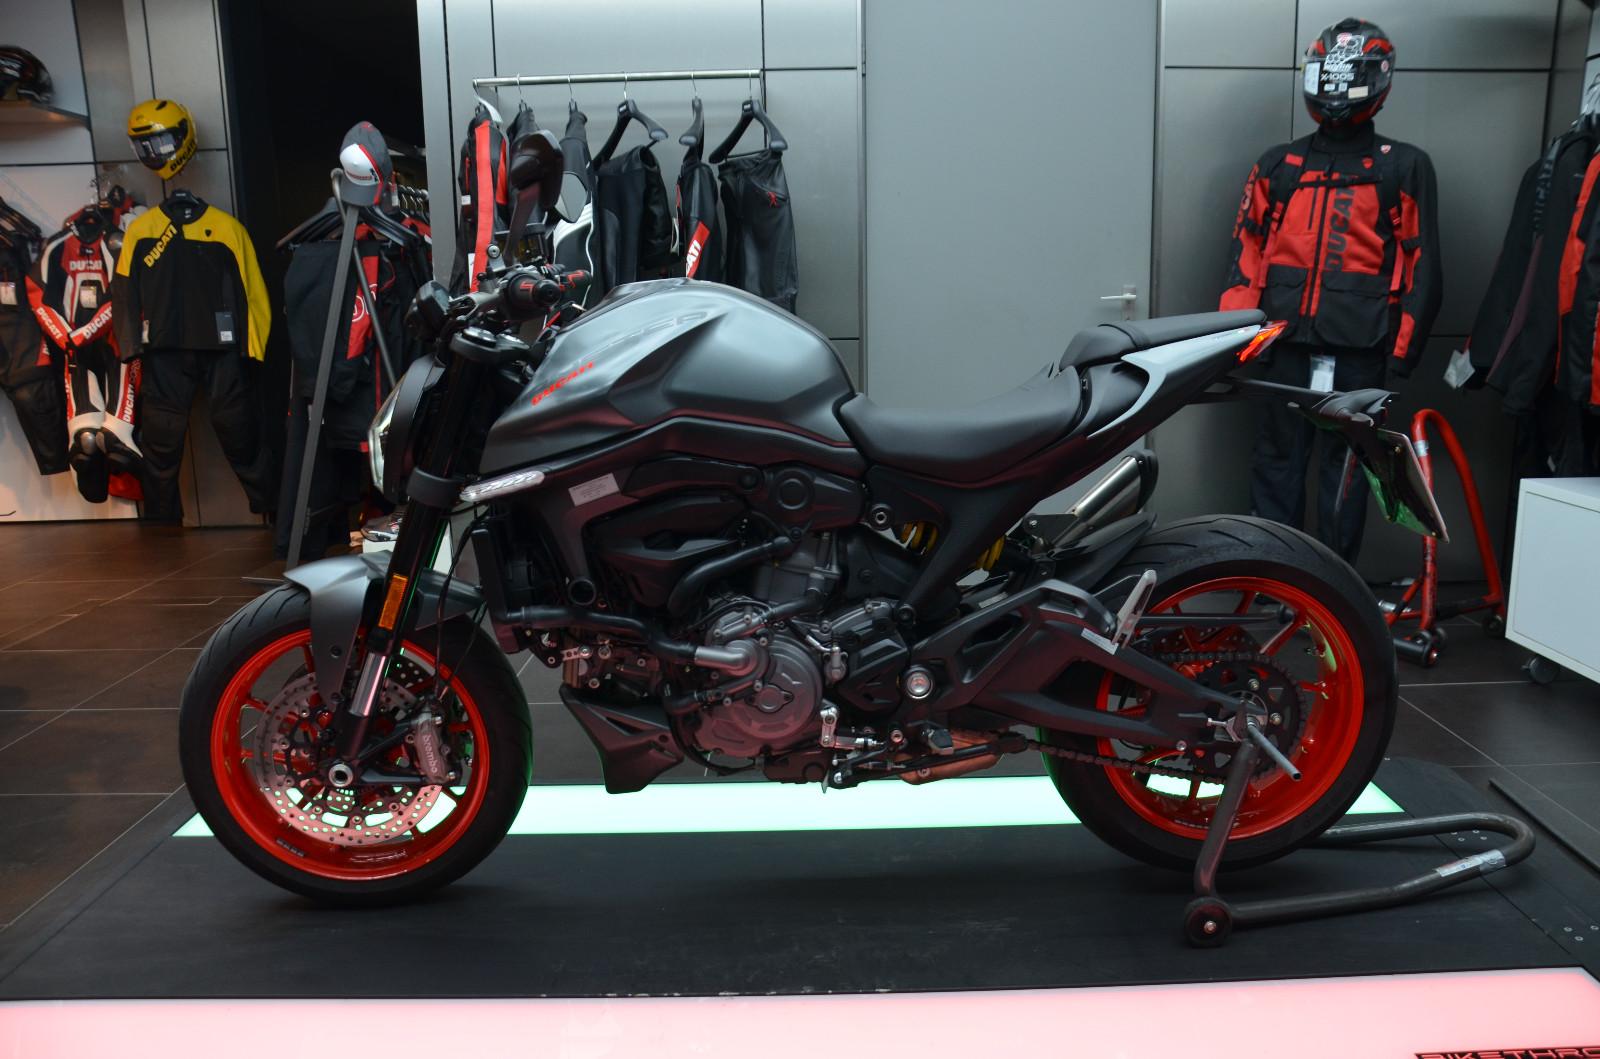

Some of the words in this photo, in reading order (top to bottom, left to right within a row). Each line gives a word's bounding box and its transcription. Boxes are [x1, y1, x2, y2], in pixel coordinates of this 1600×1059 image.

[143, 224, 178, 268] DUCATI
[1325, 187, 1356, 271] DUCAT
[36, 307, 64, 340] DUCATI
[83, 306, 113, 340] DUCAT
[122, 383, 135, 422] DUCATI
[422, 734, 438, 773] brembo
